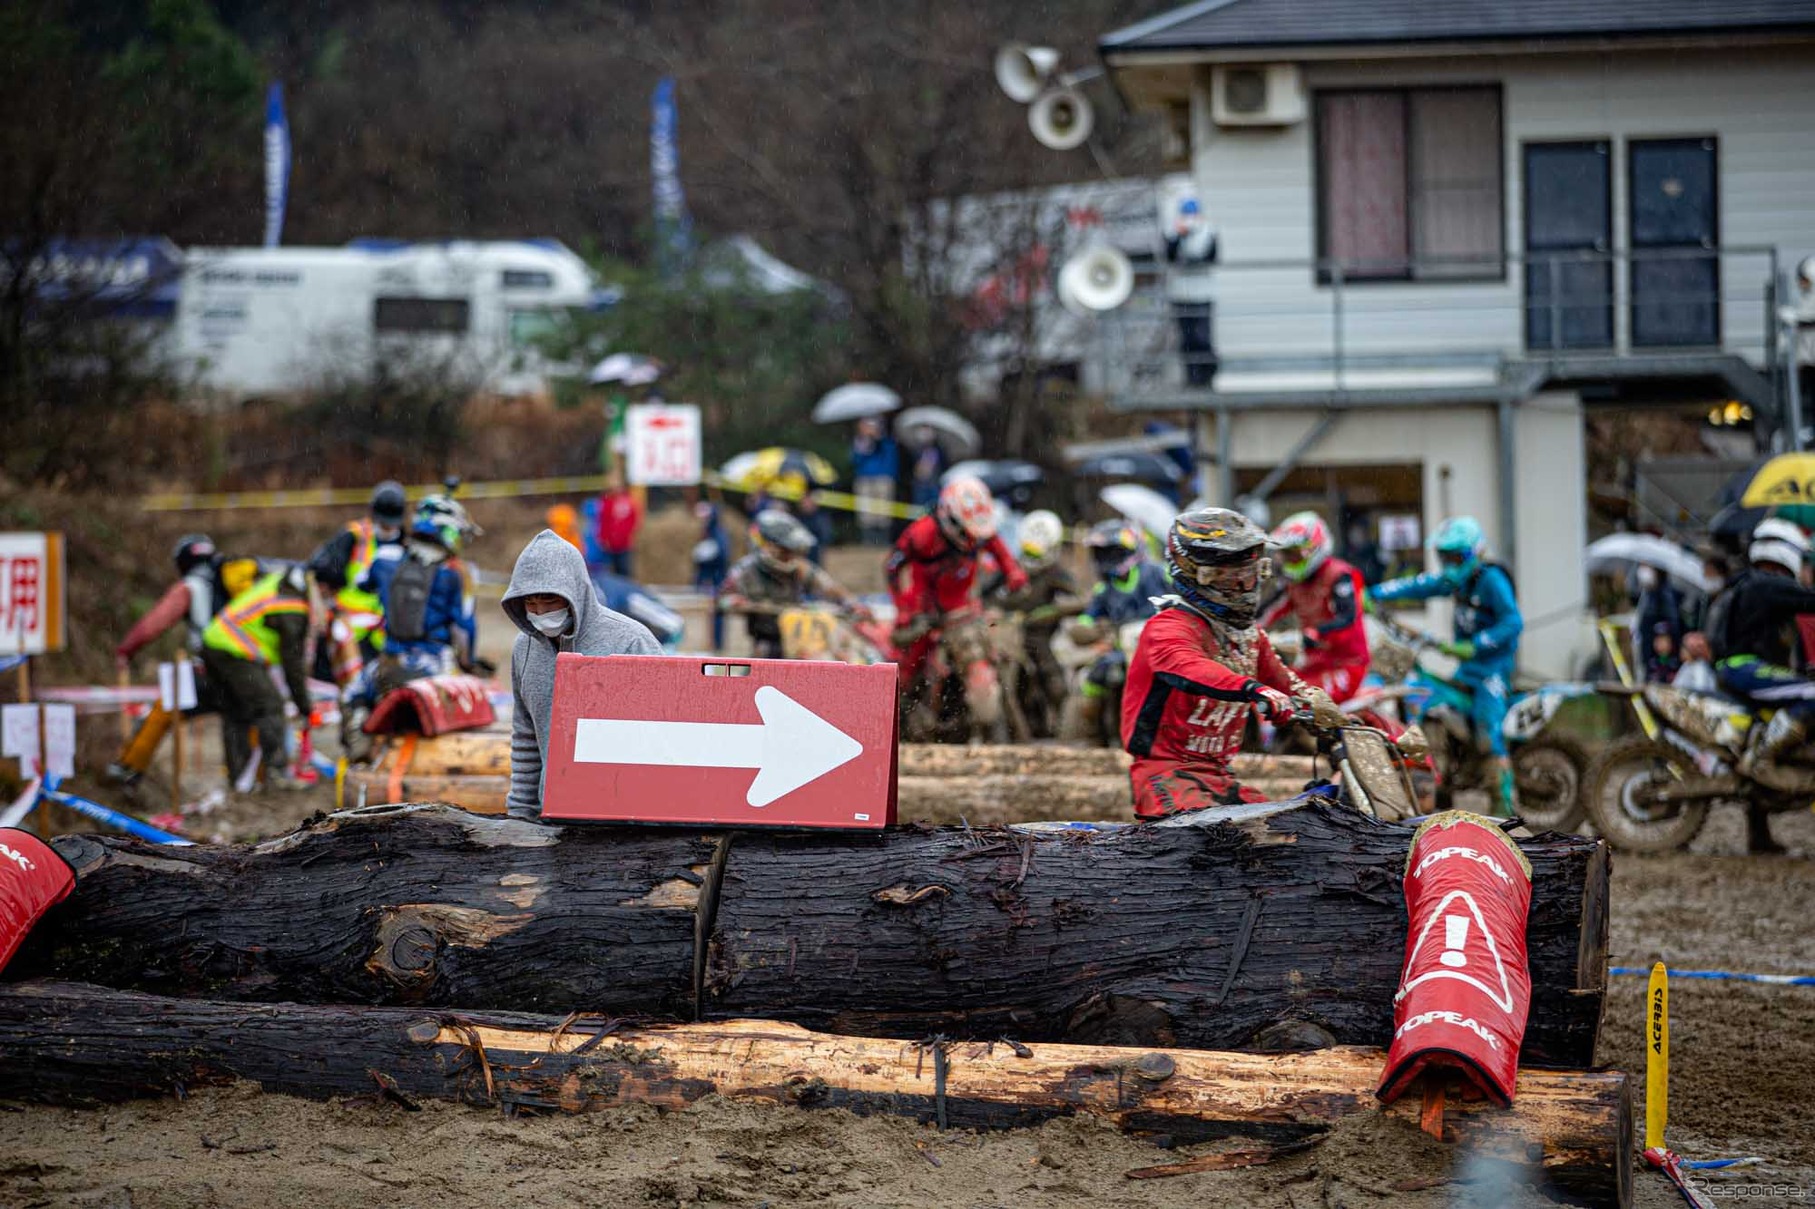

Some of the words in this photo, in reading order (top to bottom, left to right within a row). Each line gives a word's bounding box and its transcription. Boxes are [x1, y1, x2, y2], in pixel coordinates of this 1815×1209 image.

[1412, 846, 1511, 886] TOPEAK
[1395, 1010, 1497, 1050] TOPEAK
[1652, 987, 1663, 1055] ACERBIS
